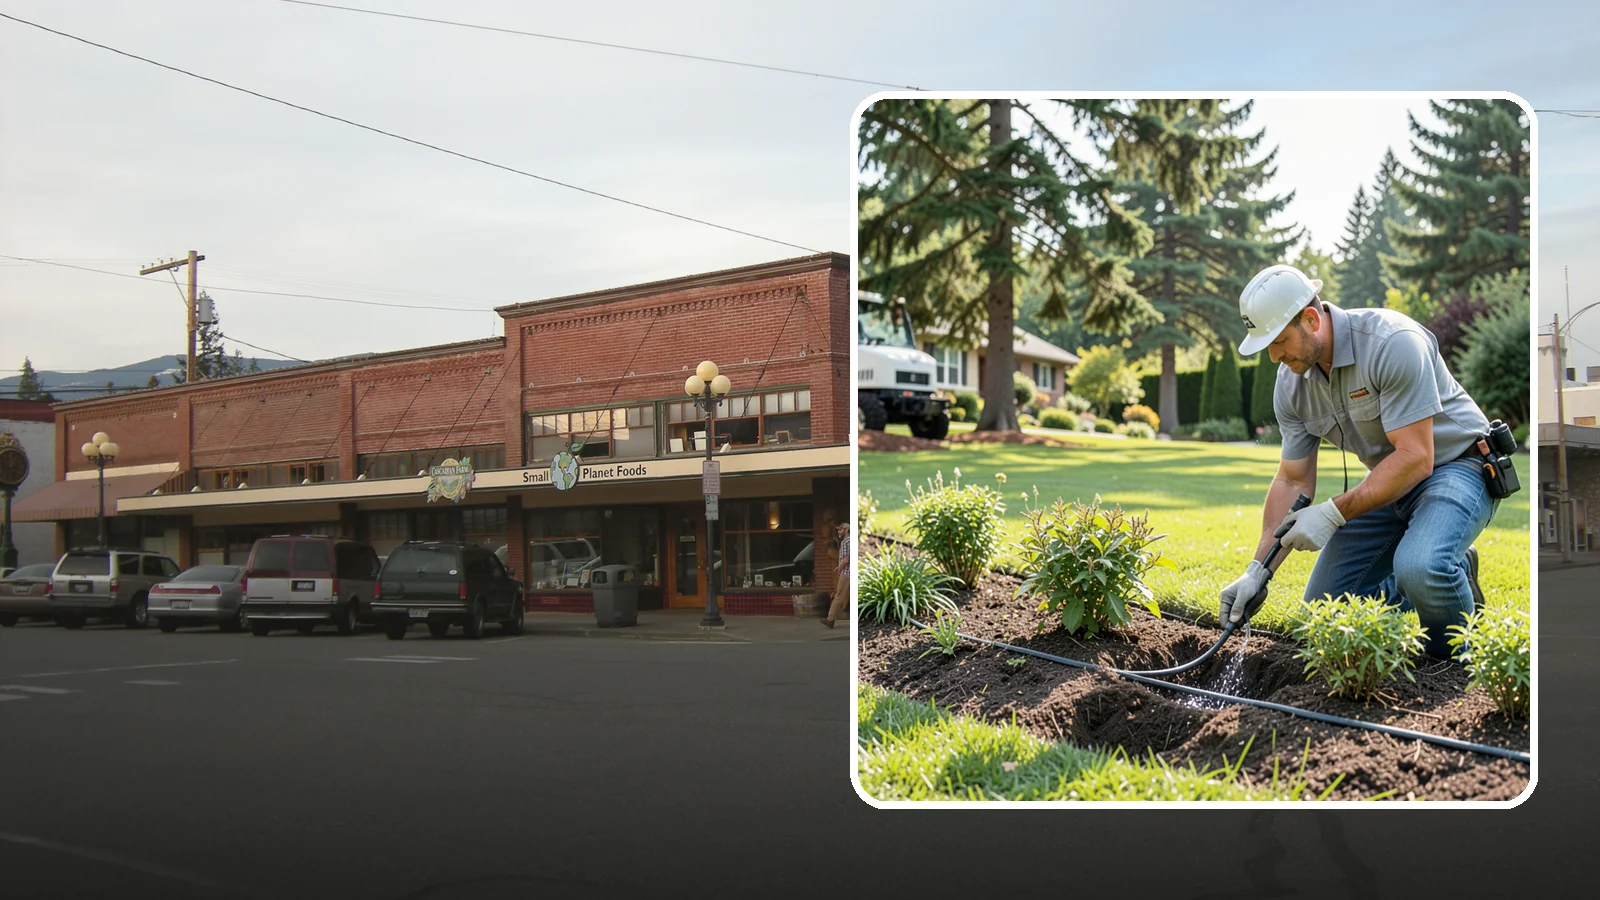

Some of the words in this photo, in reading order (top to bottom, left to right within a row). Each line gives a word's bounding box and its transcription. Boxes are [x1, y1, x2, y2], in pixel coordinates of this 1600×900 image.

[523, 471, 549, 482] Small
[583, 467, 614, 479] Planet
[617, 464, 647, 476] Foods
